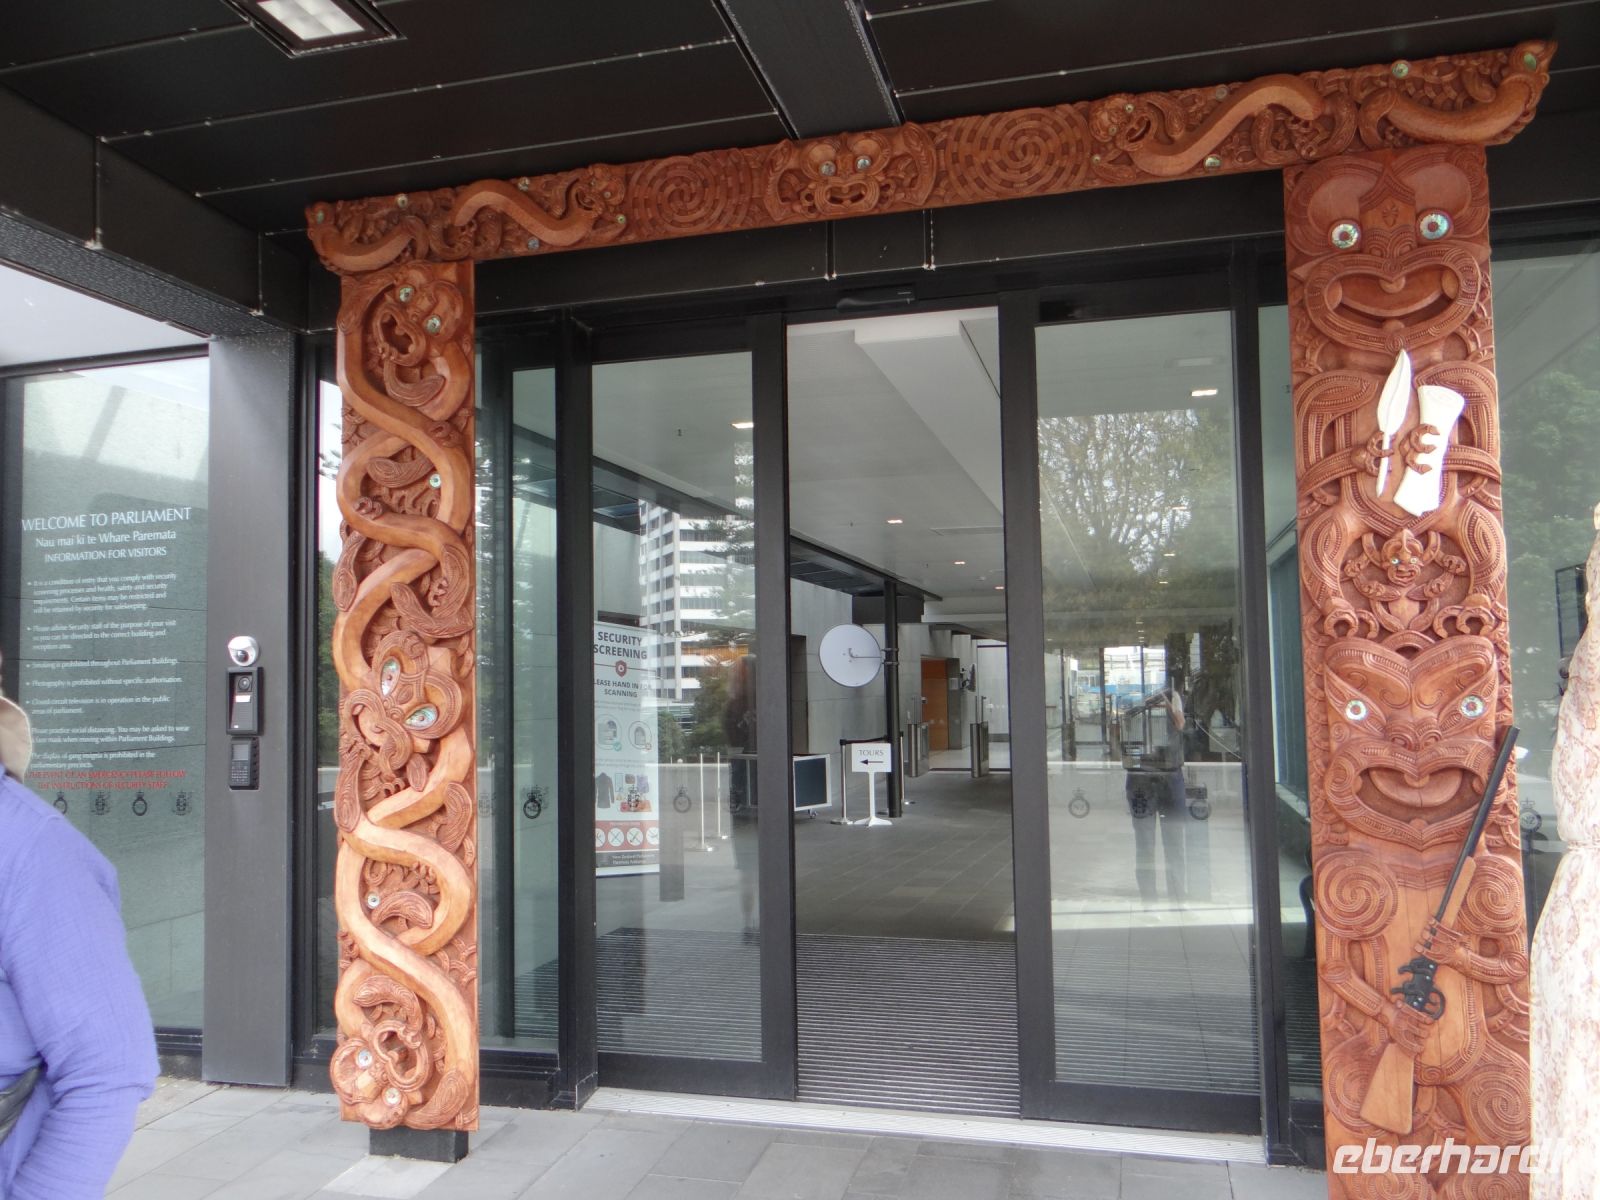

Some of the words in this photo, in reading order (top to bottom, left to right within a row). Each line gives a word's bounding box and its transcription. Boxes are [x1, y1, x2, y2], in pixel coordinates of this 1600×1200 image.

[22, 514, 87, 531] WELCOME
[90, 513, 108, 527] TO
[111, 507, 192, 525] PARLIAMENT
[36, 537, 54, 548] Nau
[57, 535, 74, 546] mai
[76, 534, 85, 545] ki
[87, 534, 97, 545] te
[99, 531, 130, 544] Whare
[133, 529, 176, 542] Paremata
[45, 550, 106, 563] INFORMATION
[108, 549, 126, 560] FOR
[128, 546, 167, 558] VISITORS
[598, 631, 642, 646] SECURITY
[594, 644, 648, 660] SCREENING
[612, 681, 631, 689] HAND
[604, 689, 638, 698] SCANNING
